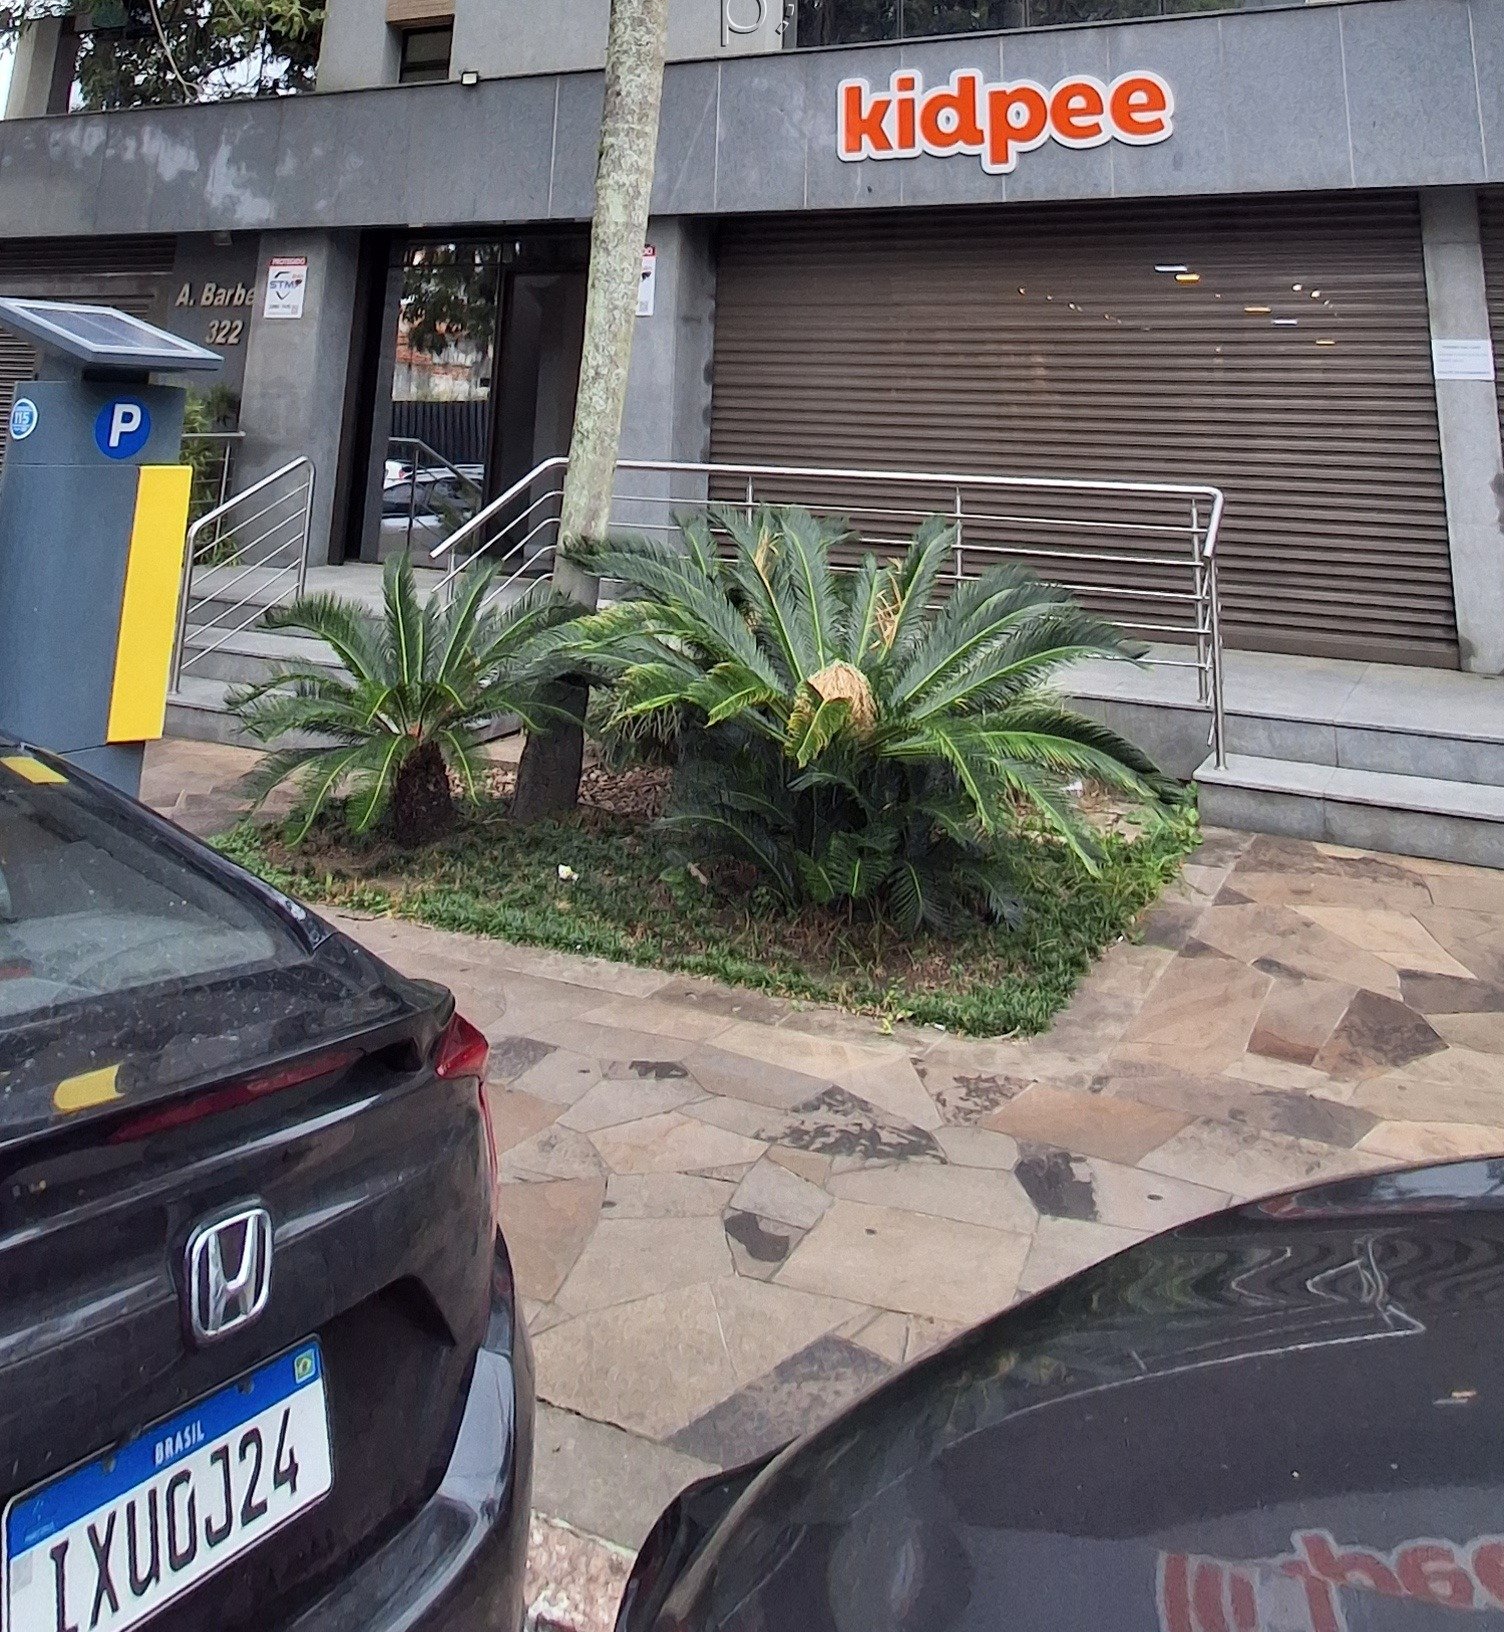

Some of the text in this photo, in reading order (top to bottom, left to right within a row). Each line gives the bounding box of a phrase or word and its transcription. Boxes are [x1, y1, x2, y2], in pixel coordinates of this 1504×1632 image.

[843, 75, 1168, 167] kidpee
[175, 282, 195, 307] A.
[205, 320, 243, 345] 322
[108, 403, 142, 448] P
[154, 1420, 205, 1468] BRASIL
